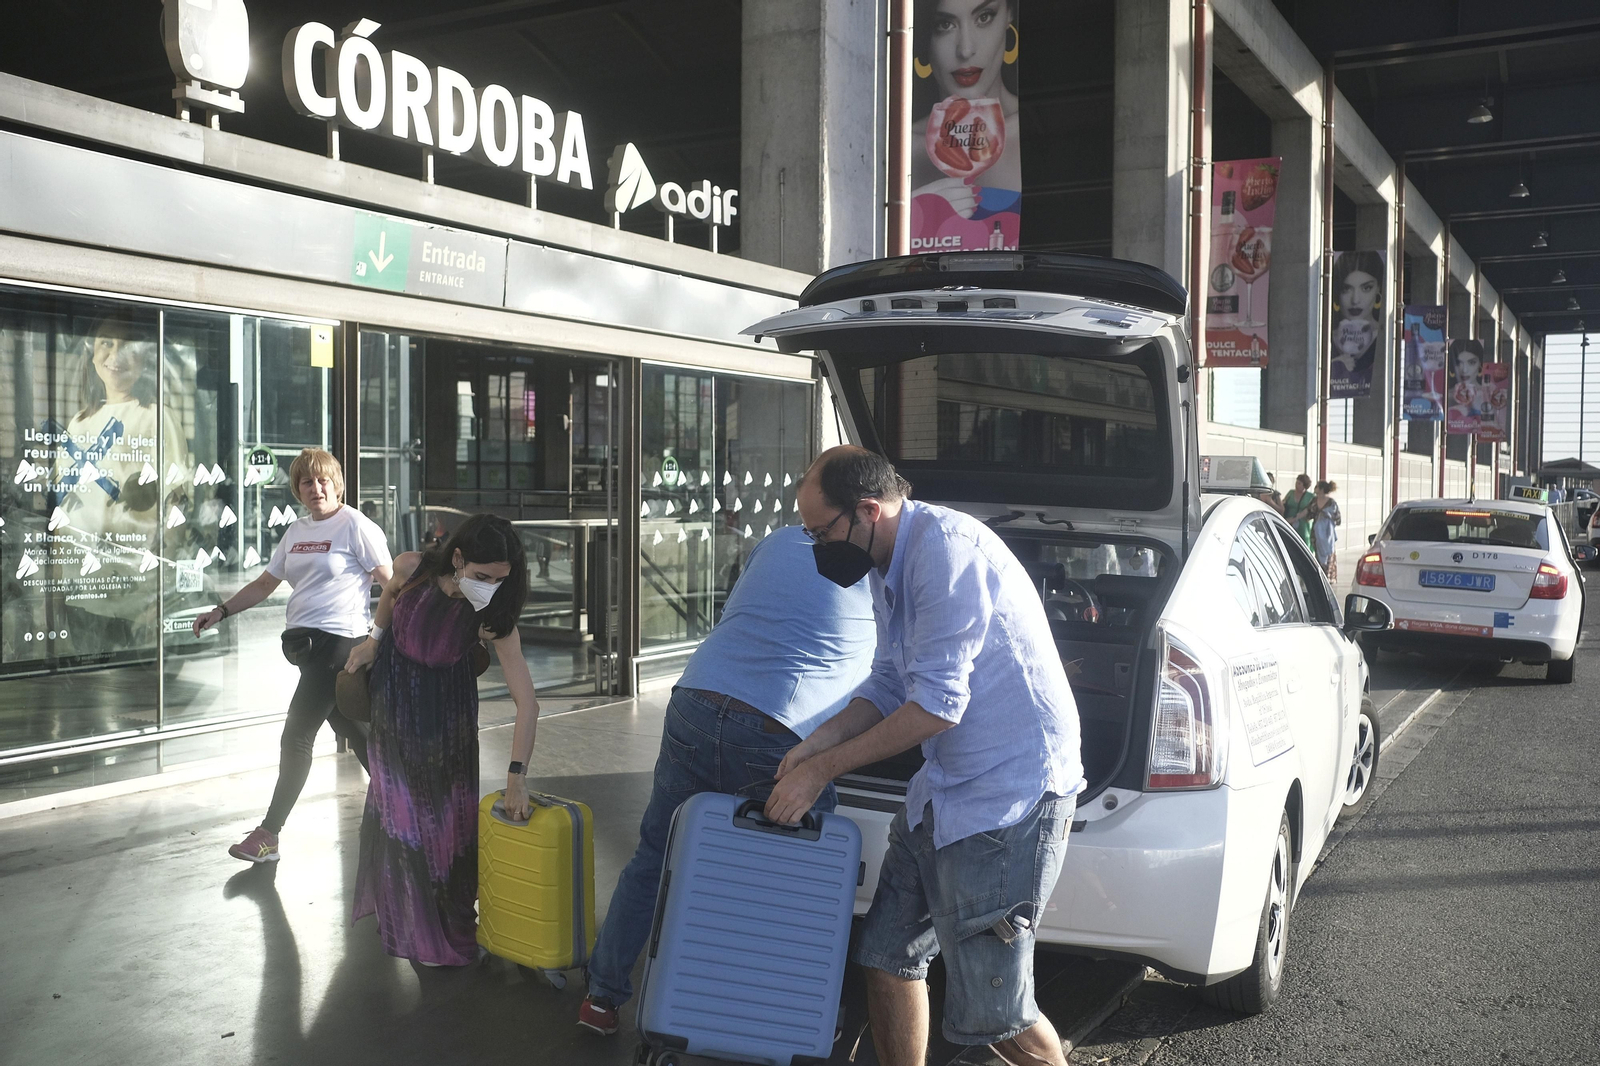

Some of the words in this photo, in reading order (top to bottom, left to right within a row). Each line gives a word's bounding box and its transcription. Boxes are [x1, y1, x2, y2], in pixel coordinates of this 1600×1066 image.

[294, 17, 594, 191] CÓRDOBA
[944, 119, 986, 137] Puerto
[660, 179, 739, 226] adif
[911, 236, 961, 249] DULCE
[421, 241, 486, 273] Entrada
[419, 270, 465, 289] ENTRANCE
[1207, 341, 1236, 349] DULCE
[1211, 349, 1268, 358] TENTACIN
[1333, 383, 1371, 391] TENTACIN
[24, 428, 68, 446] Llegué
[72, 431, 98, 445] sola
[101, 435, 110, 449] y
[112, 432, 125, 446] la
[127, 434, 158, 449] Iglesi
[24, 445, 69, 460] reunió
[74, 452, 82, 461] a
[86, 448, 103, 461] mi
[107, 449, 155, 463] familia.
[24, 482, 42, 493] un
[47, 479, 91, 493] futuro.
[1522, 488, 1541, 499] TAXI
[24, 533, 33, 543] X
[35, 532, 76, 544] Blanca,
[80, 532, 89, 543] X
[105, 532, 112, 542] X
[115, 531, 147, 542] tantos
[24, 547, 47, 556] Marca
[50, 547, 57, 555] la
[59, 546, 65, 555] X
[302, 543, 327, 551] adidas
[34, 555, 79, 565] declaración
[1482, 552, 1498, 560] 178
[23, 579, 55, 587] DESCUBRE
[72, 577, 105, 585] HISTORIAS
[1430, 574, 1462, 585] 5876
[1466, 576, 1491, 588] JWR
[39, 585, 74, 593] AYUDADAS
[65, 592, 107, 602] portantos.es
